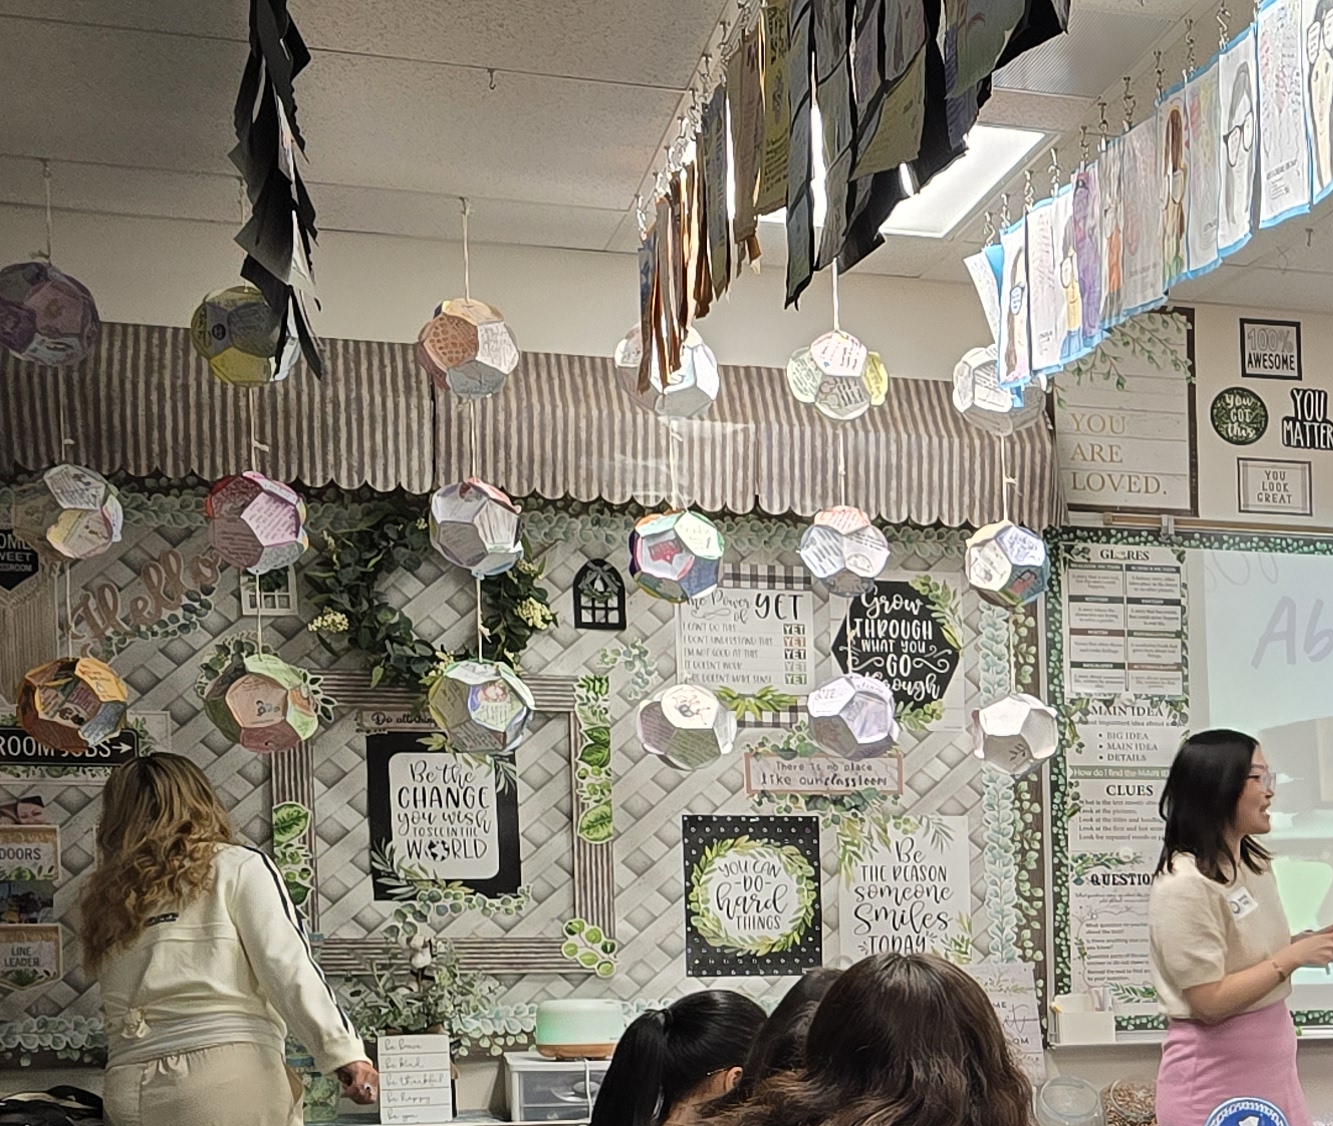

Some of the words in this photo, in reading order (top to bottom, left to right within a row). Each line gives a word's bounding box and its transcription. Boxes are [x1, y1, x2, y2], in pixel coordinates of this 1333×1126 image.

[1247, 328, 1293, 353] 100%
[1247, 353, 1295, 371] AWESOME
[1291, 389, 1327, 422] YOU
[1070, 413, 1126, 435] YOU
[1070, 443, 1123, 464] ARE
[1071, 472, 1167, 495] LOVED.
[1264, 470, 1286, 481] YOU
[1261, 481, 1289, 493] LOOK
[1256, 492, 1292, 504] GREAT
[755, 592, 803, 620] YET
[861, 587, 924, 618] Grow
[783, 625, 806, 635] YET
[853, 617, 933, 640] THROUGH
[784, 637, 807, 647] YET
[861, 638, 896, 653] WHAT
[900, 639, 926, 654] YOU
[784, 649, 807, 660] YET
[886, 654, 912, 677] GO
[785, 674, 808, 685] YET
[1090, 705, 1127, 717] MAIN
[1134, 706, 1164, 717] IDEA
[1106, 731, 1123, 740] BIG
[1125, 732, 1149, 740] IDEA
[1106, 743, 1136, 751] MAIN
[1107, 753, 1147, 762] DETAILS
[410, 760, 436, 783] Be
[436, 762, 476, 789] the
[776, 761, 803, 772] There
[843, 761, 873, 773] place
[760, 772, 792, 786] like
[398, 786, 490, 810] CHANGE
[1105, 784, 1154, 796] CLUES
[398, 810, 437, 836] you
[442, 809, 492, 834] wish
[0, 848, 42, 861] DOORS
[894, 837, 927, 864] Be
[717, 860, 749, 879] YOU
[752, 859, 782, 879] CAN
[861, 864, 887, 882] THE
[892, 864, 948, 883] REASON
[716, 882, 788, 920] hard
[853, 885, 954, 905] someone
[735, 914, 781, 931] THINGS
[853, 901, 954, 936] Smiles
[11, 946, 32, 957] LINE
[867, 934, 927, 955] TODAY
[4, 957, 40, 967] LEADER
